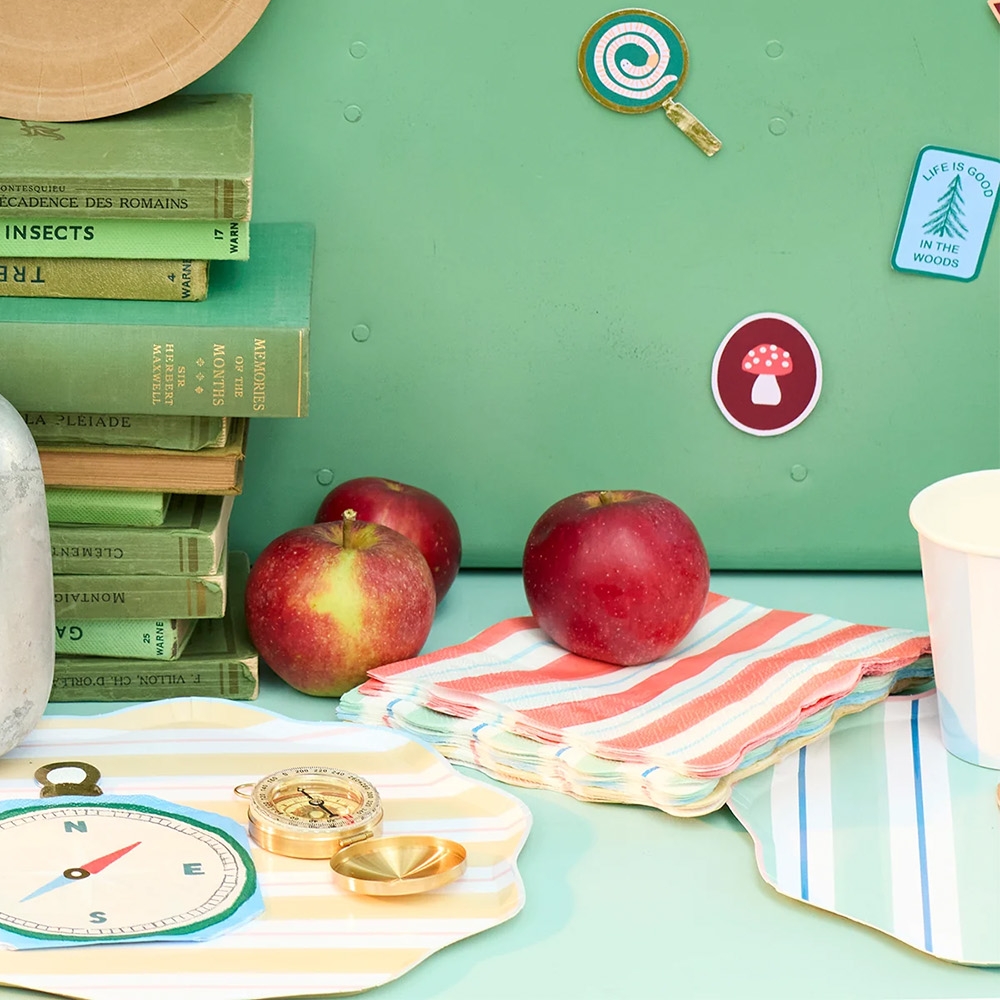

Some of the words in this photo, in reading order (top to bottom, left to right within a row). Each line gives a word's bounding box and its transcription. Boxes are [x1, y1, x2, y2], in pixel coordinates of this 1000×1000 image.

[922, 162, 949, 182] LIFE
[952, 162, 965, 172] IS
[967, 166, 994, 198] GOOD
[85, 196, 113, 209] DES
[119, 197, 189, 210] ROMAINS
[5, 224, 95, 241] INSECTS
[214, 228, 224, 240] 17
[919, 239, 933, 249] IN
[936, 241, 960, 254] THE
[913, 252, 960, 268] WOODS
[167, 273, 176, 282] 4
[235, 356, 244, 373] OF
[152, 343, 161, 405] MAXWELL
[164, 343, 174, 406] HERBERT
[177, 366, 186, 388] SIR
[212, 343, 225, 406] MONTHS
[253, 338, 266, 411] MEMORIES
[234, 376, 244, 398] THE
[56, 626, 83, 641] GA
[143, 633, 150, 644] 25
[156, 621, 164, 655] WARNE
[110, 675, 132, 686] CH.
[137, 674, 186, 685] VILLON,
[191, 674, 200, 684] F.
[64, 820, 87, 833] N
[183, 863, 205, 876] E
[89, 911, 108, 924] S
